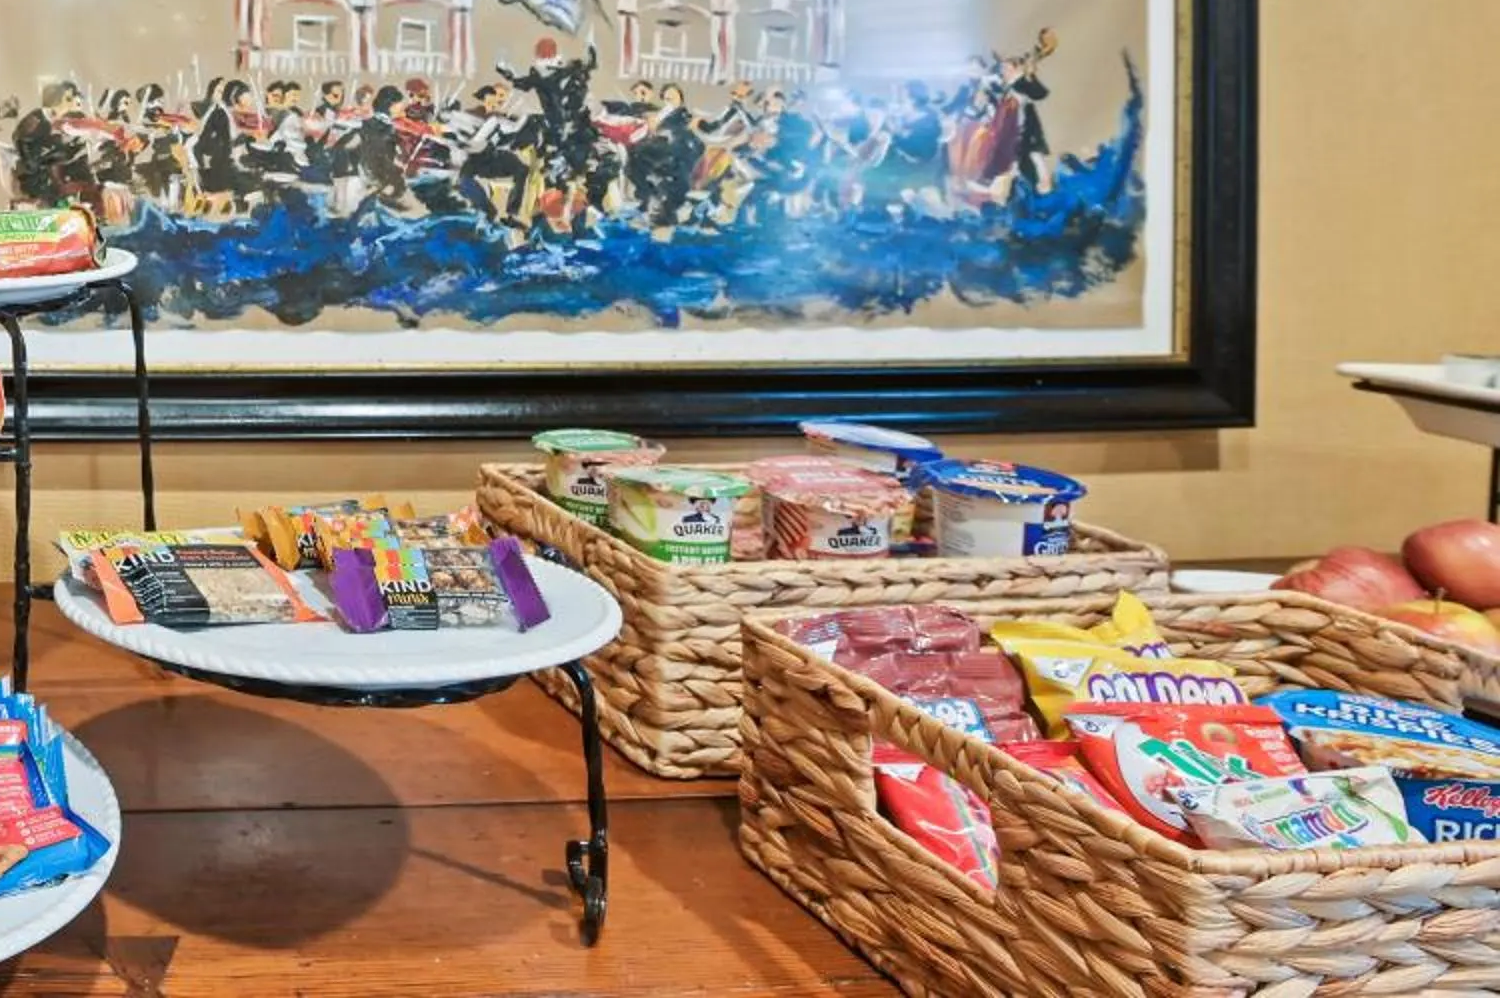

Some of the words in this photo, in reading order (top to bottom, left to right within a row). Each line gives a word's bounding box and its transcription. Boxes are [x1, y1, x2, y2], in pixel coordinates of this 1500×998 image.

[571, 485, 609, 498] QUAK
[673, 524, 725, 537] QUAKER
[379, 579, 432, 595] KIND
[1423, 782, 1500, 818] Kellog
[1435, 818, 1500, 842] RIC
